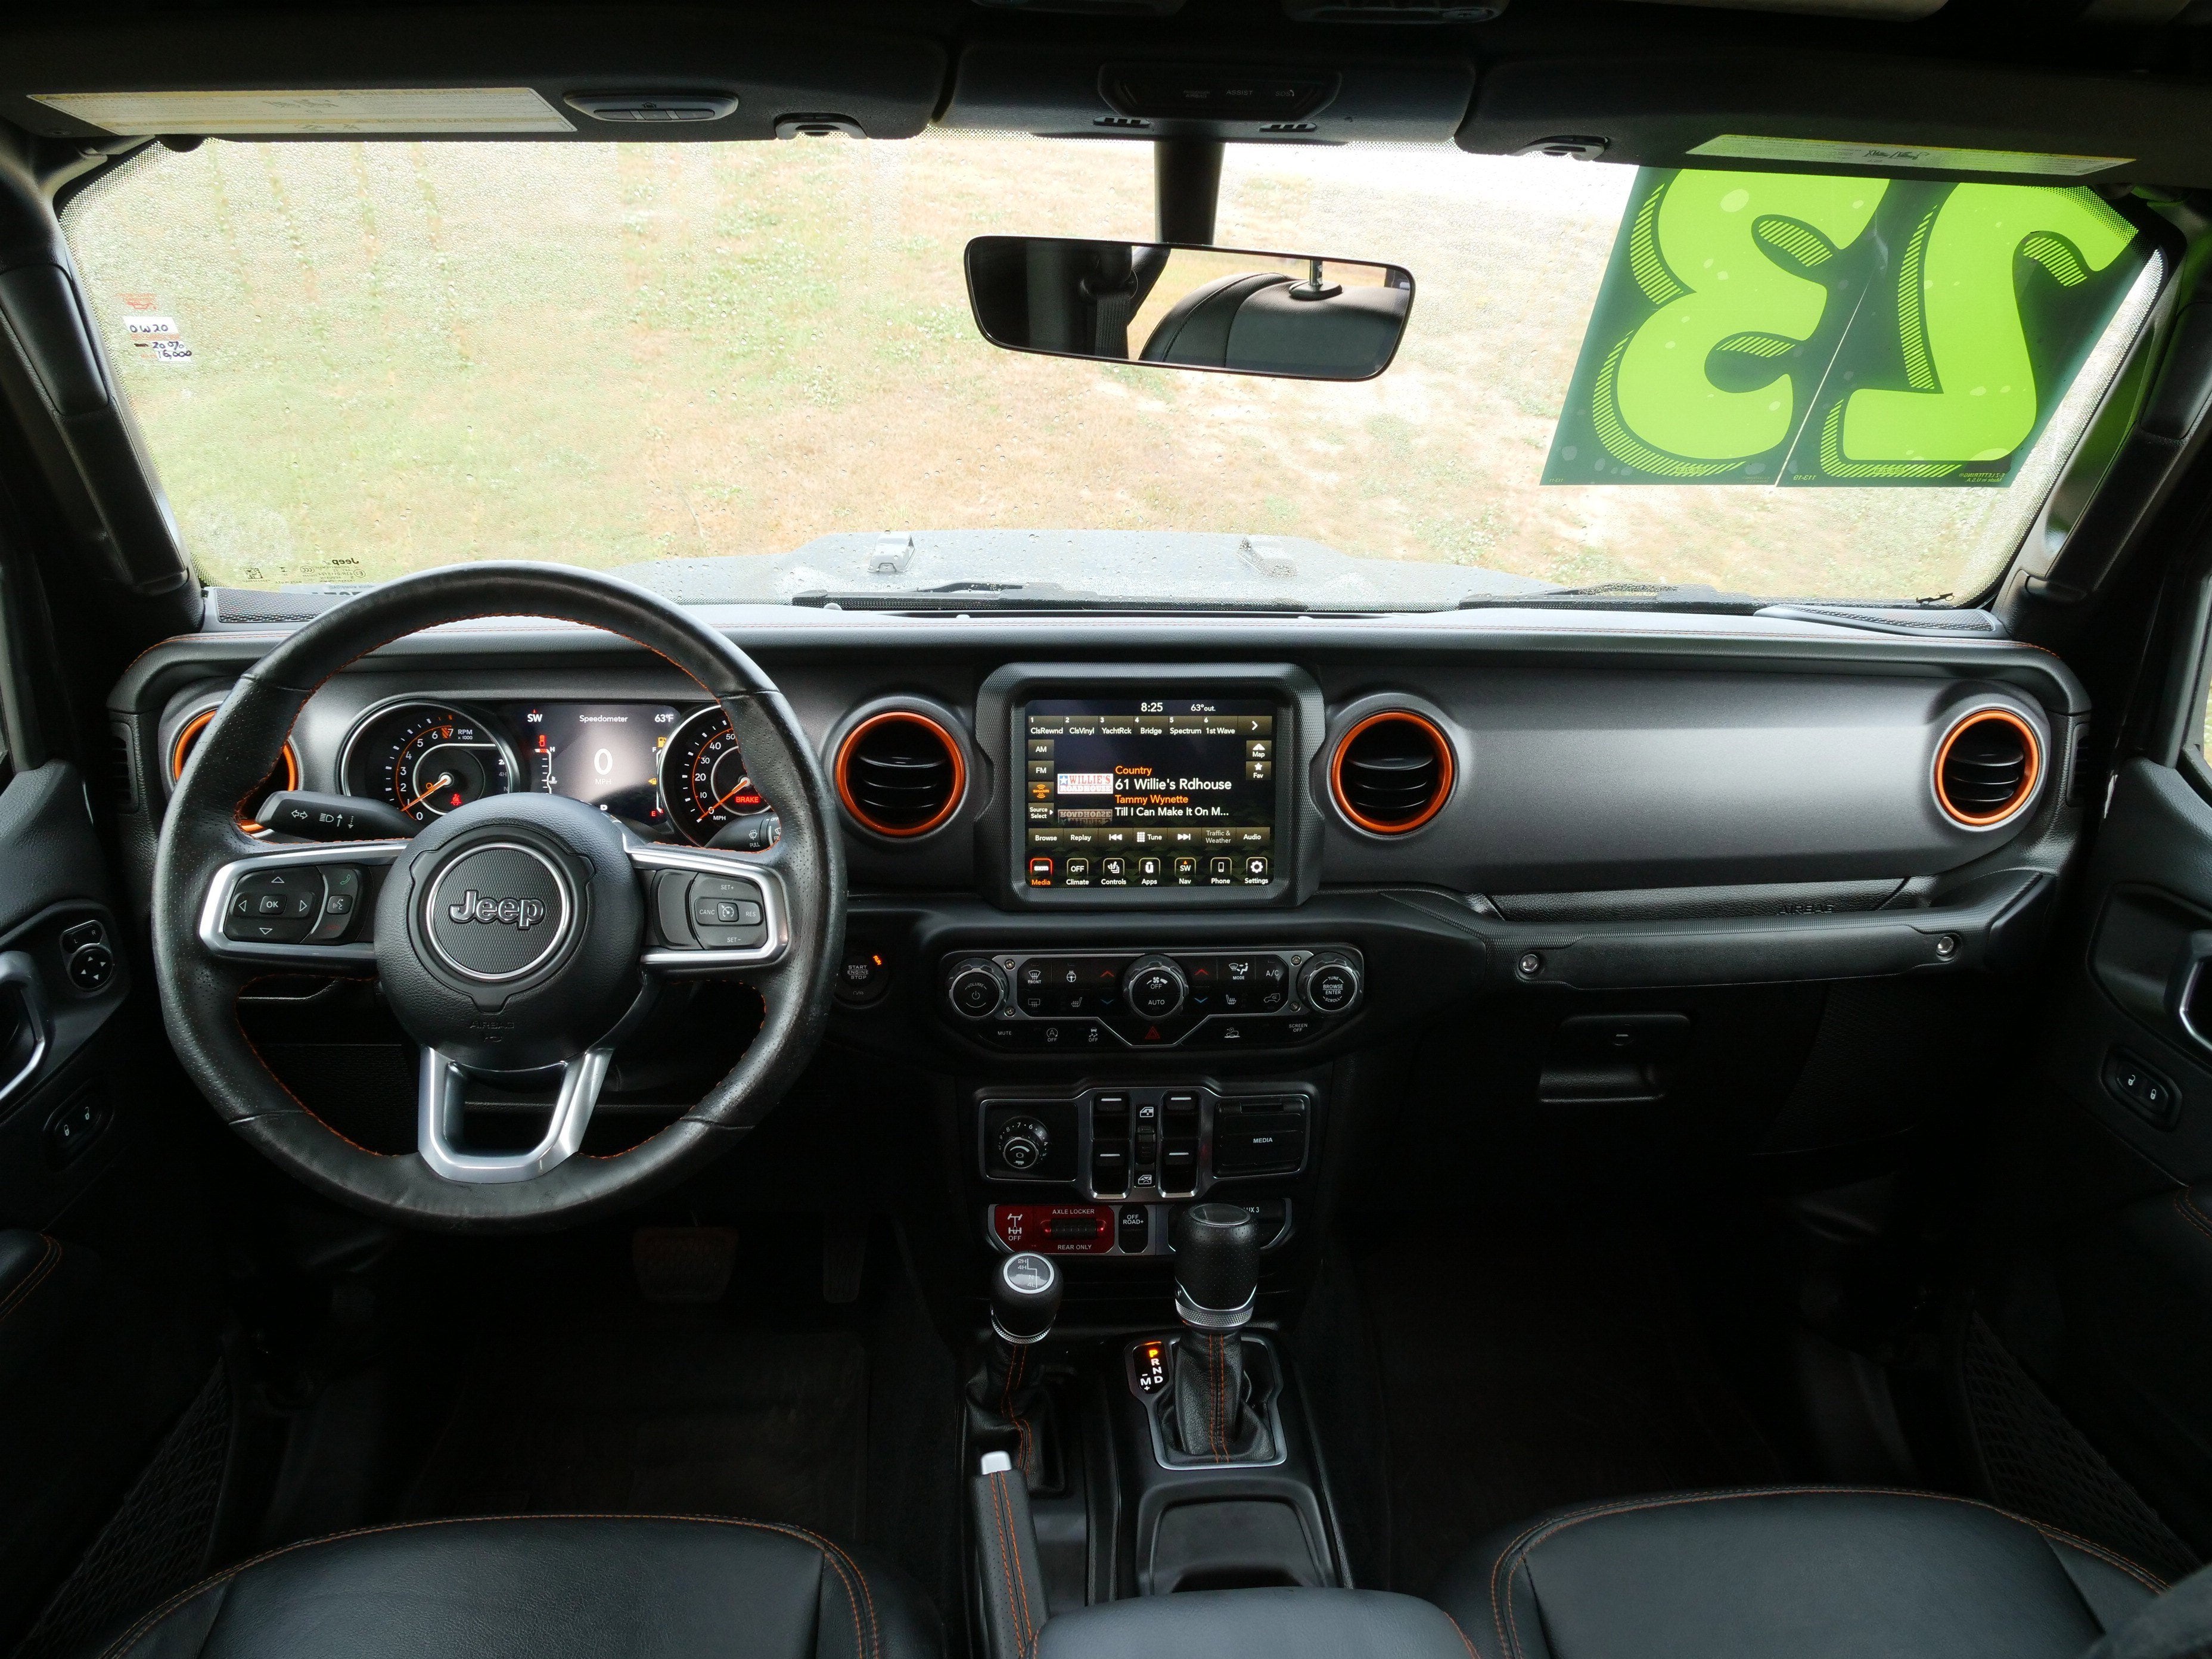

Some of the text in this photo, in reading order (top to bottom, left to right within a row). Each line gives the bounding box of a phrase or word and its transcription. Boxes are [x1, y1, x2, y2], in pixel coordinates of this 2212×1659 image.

[1141, 703, 1163, 712] 8:25
[579, 714, 628, 723] Speedometer
[655, 714, 674, 722] 63°F
[594, 748, 613, 775] 0
[1115, 766, 1152, 775] Country
[1070, 775, 1110, 784] WILLIE'S
[1115, 778, 1231, 790] 61 Willie's Rdhouse
[1115, 795, 1188, 804] Tammy Wynette
[1115, 807, 1127, 816] Till
[1136, 808, 1154, 816] Can
[1158, 807, 1183, 816] Make
[1186, 808, 1192, 816] It
[1195, 808, 1208, 816] On
[449, 890, 545, 930] Jeep
